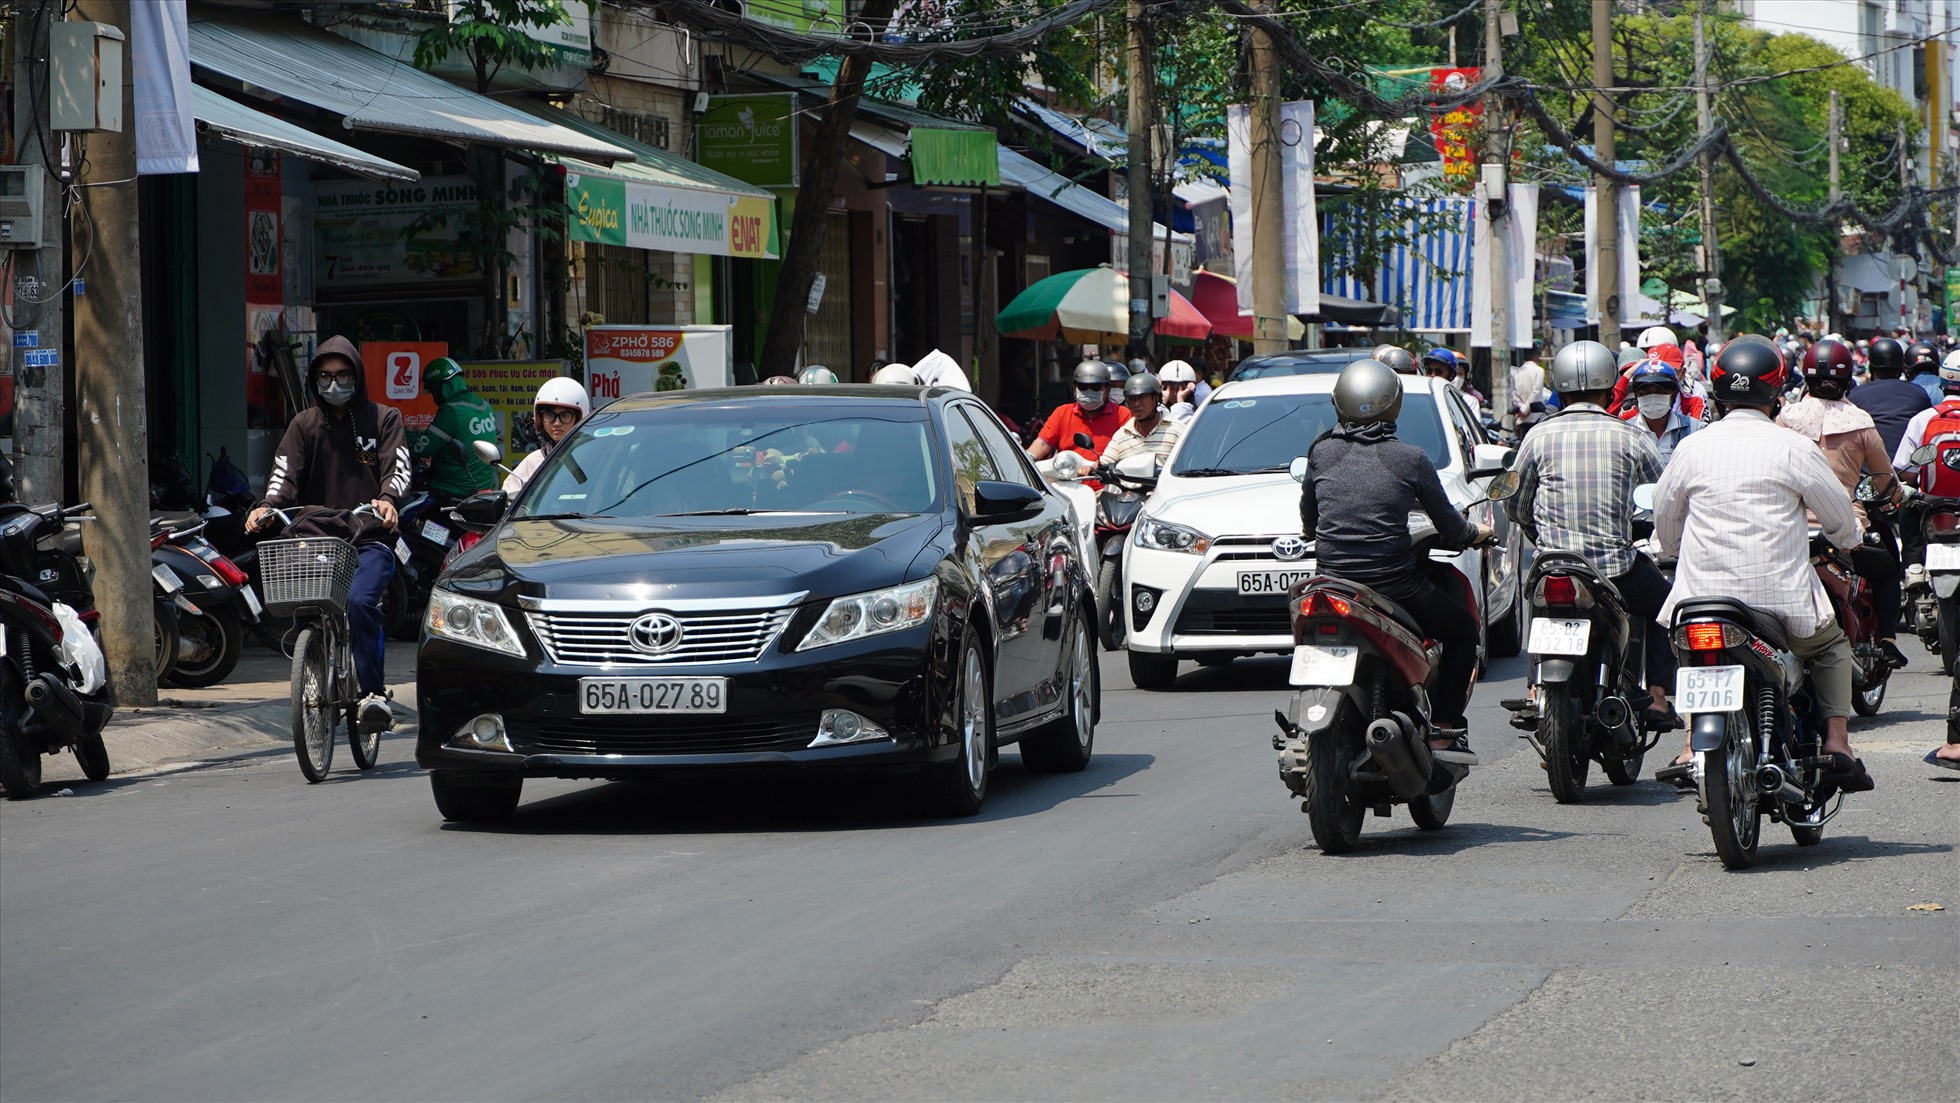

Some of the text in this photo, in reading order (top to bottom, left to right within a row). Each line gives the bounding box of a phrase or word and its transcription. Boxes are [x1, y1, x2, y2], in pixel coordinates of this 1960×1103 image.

[318, 184, 480, 207] NHÀ THUỐC SONG MINH
[631, 198, 723, 242] NHÀ THUỐC SONG MINH
[325, 255, 338, 280] 7
[611, 333, 674, 348] ZPHỞ 586
[620, 348, 650, 357] 0345678
[651, 348, 665, 357] 586
[472, 369, 487, 378] 586
[489, 369, 508, 379] Phục
[510, 369, 520, 379] Vụ
[522, 368, 537, 378] Các
[591, 369, 621, 399] Phở
[1534, 636, 1584, 652] 032.18
[586, 682, 720, 709] 65A-027.89
[1686, 689, 1733, 709] 9706
